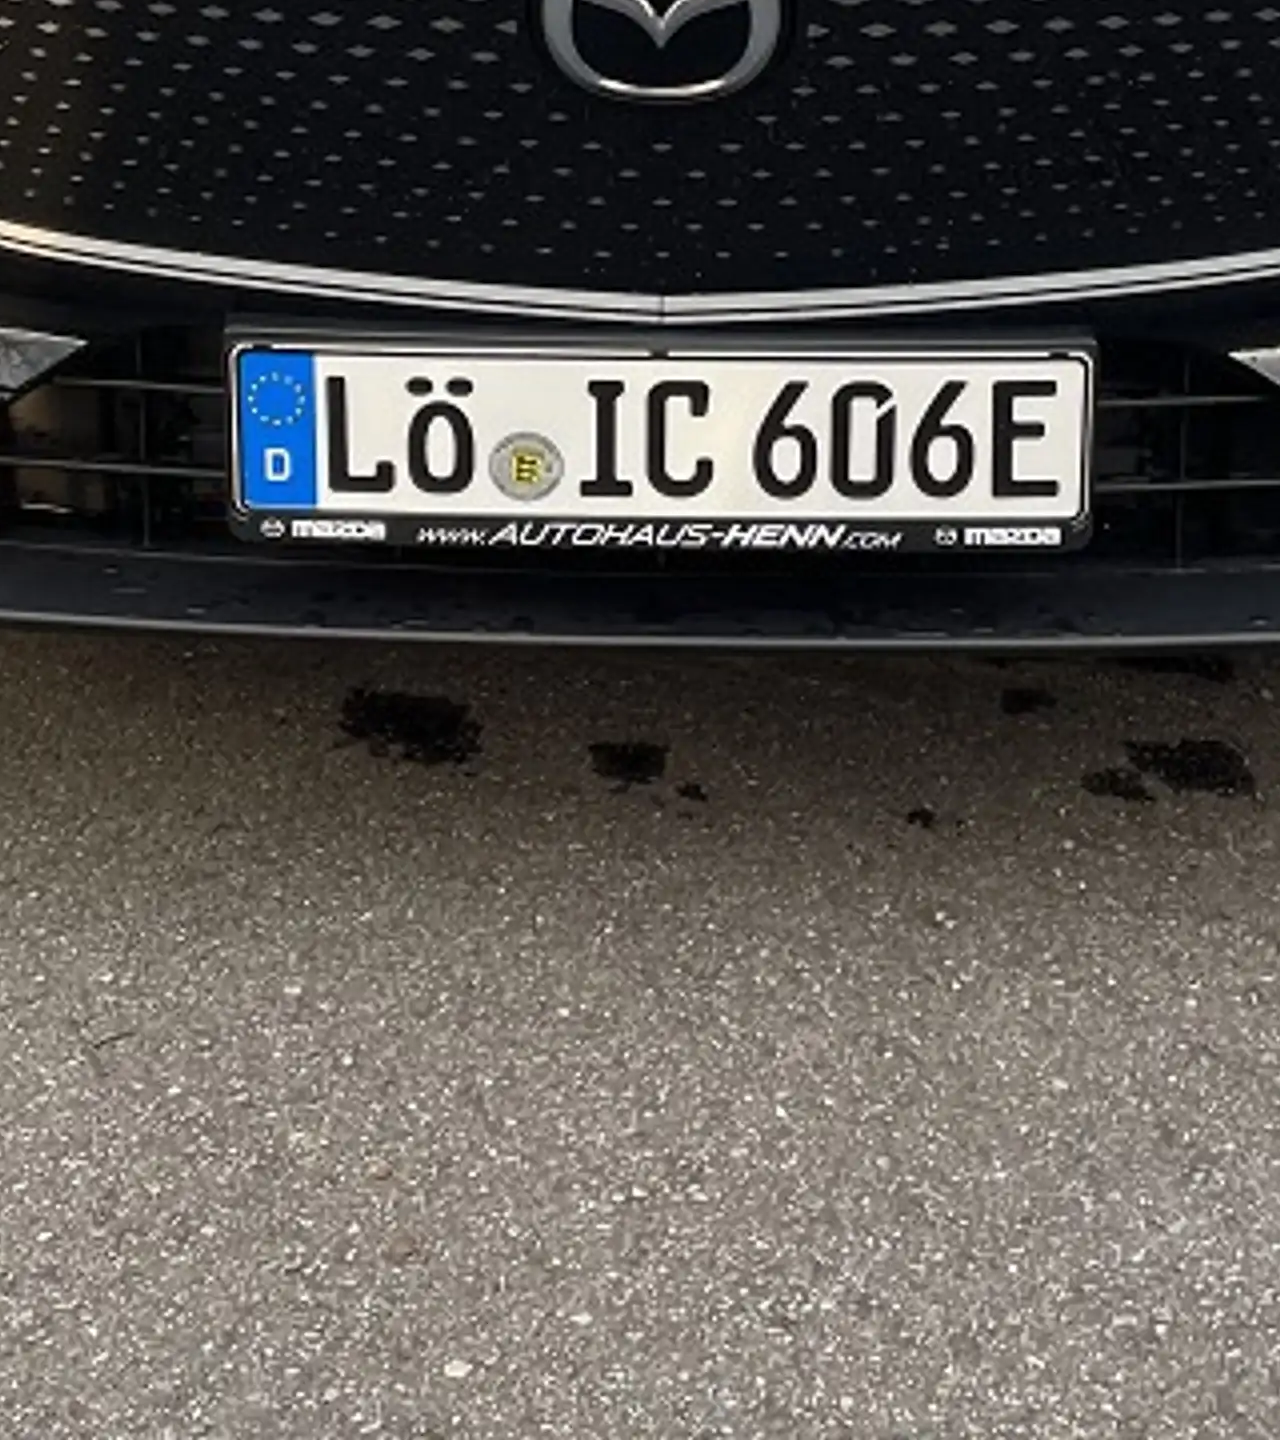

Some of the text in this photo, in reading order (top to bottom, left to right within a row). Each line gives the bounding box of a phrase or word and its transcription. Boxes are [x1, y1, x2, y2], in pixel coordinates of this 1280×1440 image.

[579, 379, 715, 499] IC
[752, 379, 1060, 500] 606E
[263, 446, 291, 482] D
[290, 519, 386, 541] mazda
[963, 526, 1062, 546] mazda
